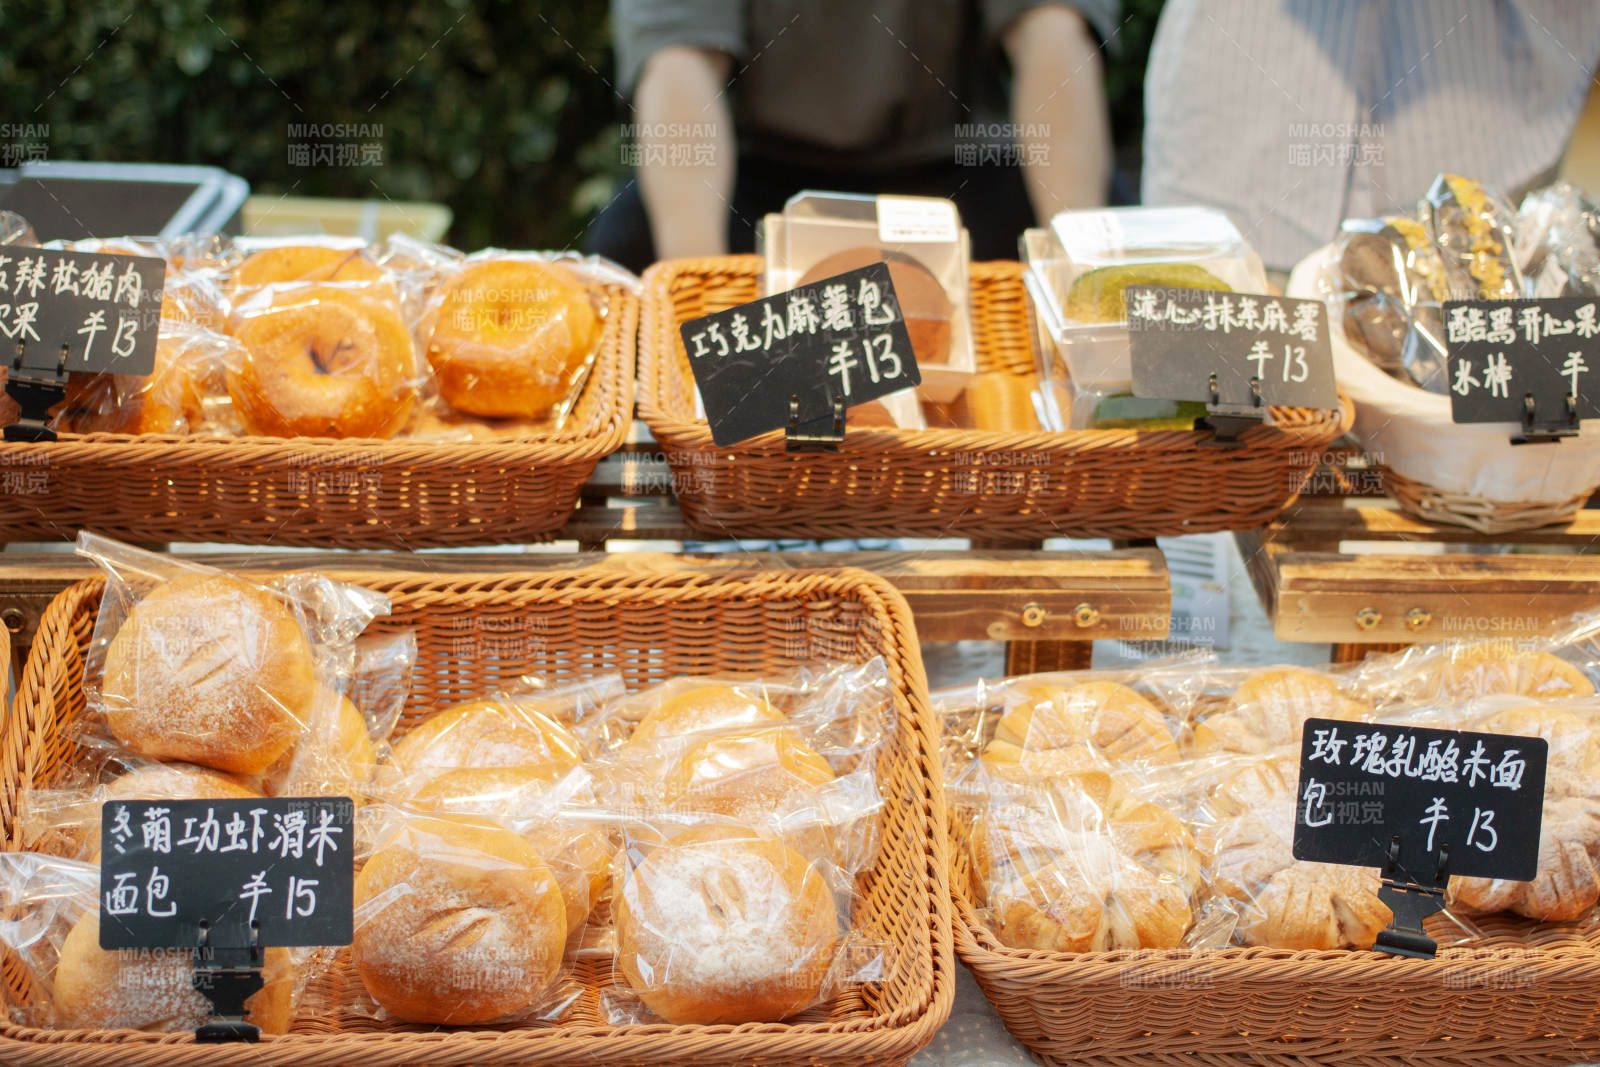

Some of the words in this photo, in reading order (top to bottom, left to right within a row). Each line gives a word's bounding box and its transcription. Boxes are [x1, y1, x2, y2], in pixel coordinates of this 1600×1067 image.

[691, 278, 896, 358] 巧克力麻薯包
[1447, 303, 1600, 345] 酷黑开心果
[1308, 727, 1527, 791] 玫瑰乳酪米面
[1302, 777, 1332, 828] 包
[105, 866, 178, 918] 面包
